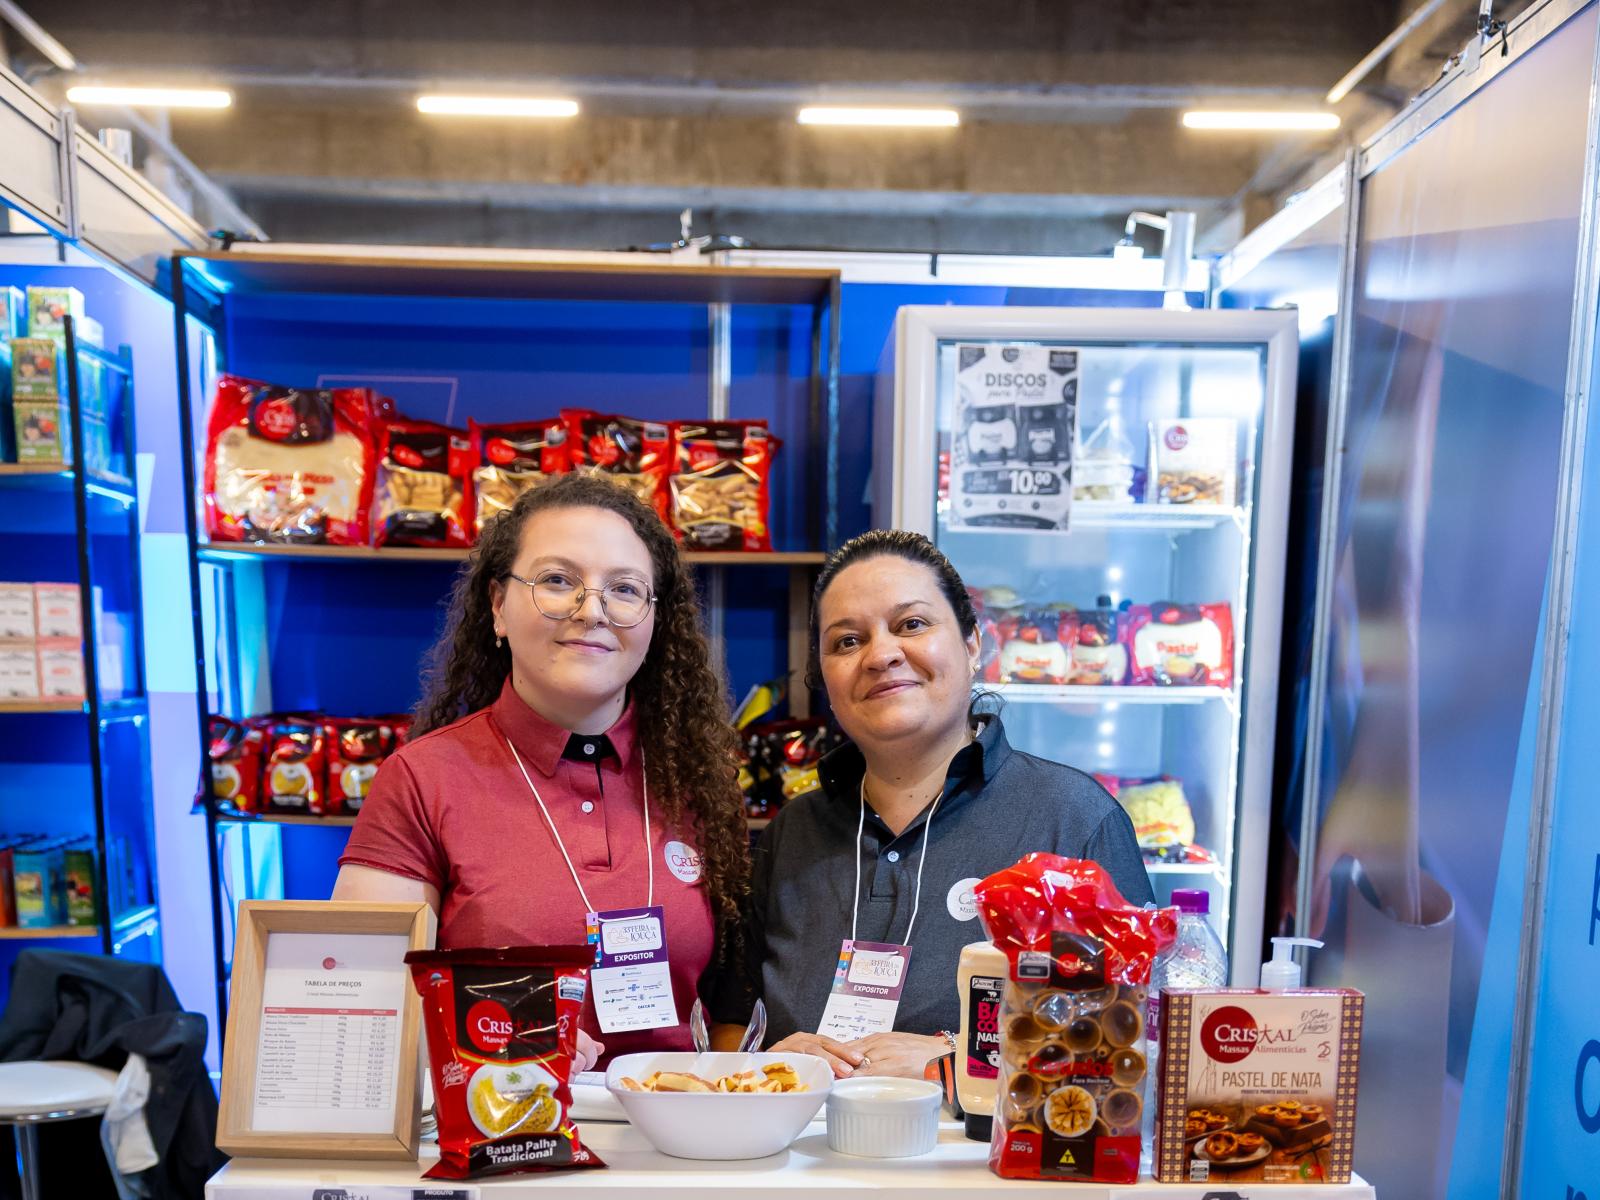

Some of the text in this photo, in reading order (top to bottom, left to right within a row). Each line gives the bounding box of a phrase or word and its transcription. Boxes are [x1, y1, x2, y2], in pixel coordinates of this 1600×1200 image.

[1009, 470, 1052, 494] 10,00
[671, 855, 704, 867] CRIS
[614, 951, 654, 962] EXPOSITOR
[853, 984, 889, 995] EXPOSITOR
[977, 1020, 998, 1033] CO
[977, 1031, 1001, 1043] NAIS
[1214, 1023, 1297, 1044] CRISTAL
[1219, 1044, 1307, 1053] Massas Alimentícias
[1222, 1071, 1322, 1088] PASTEL DE NATA
[486, 1139, 557, 1156] Batata Palha
[1010, 1144, 1033, 1153] 200 g
[490, 1147, 554, 1165] Tradicional
